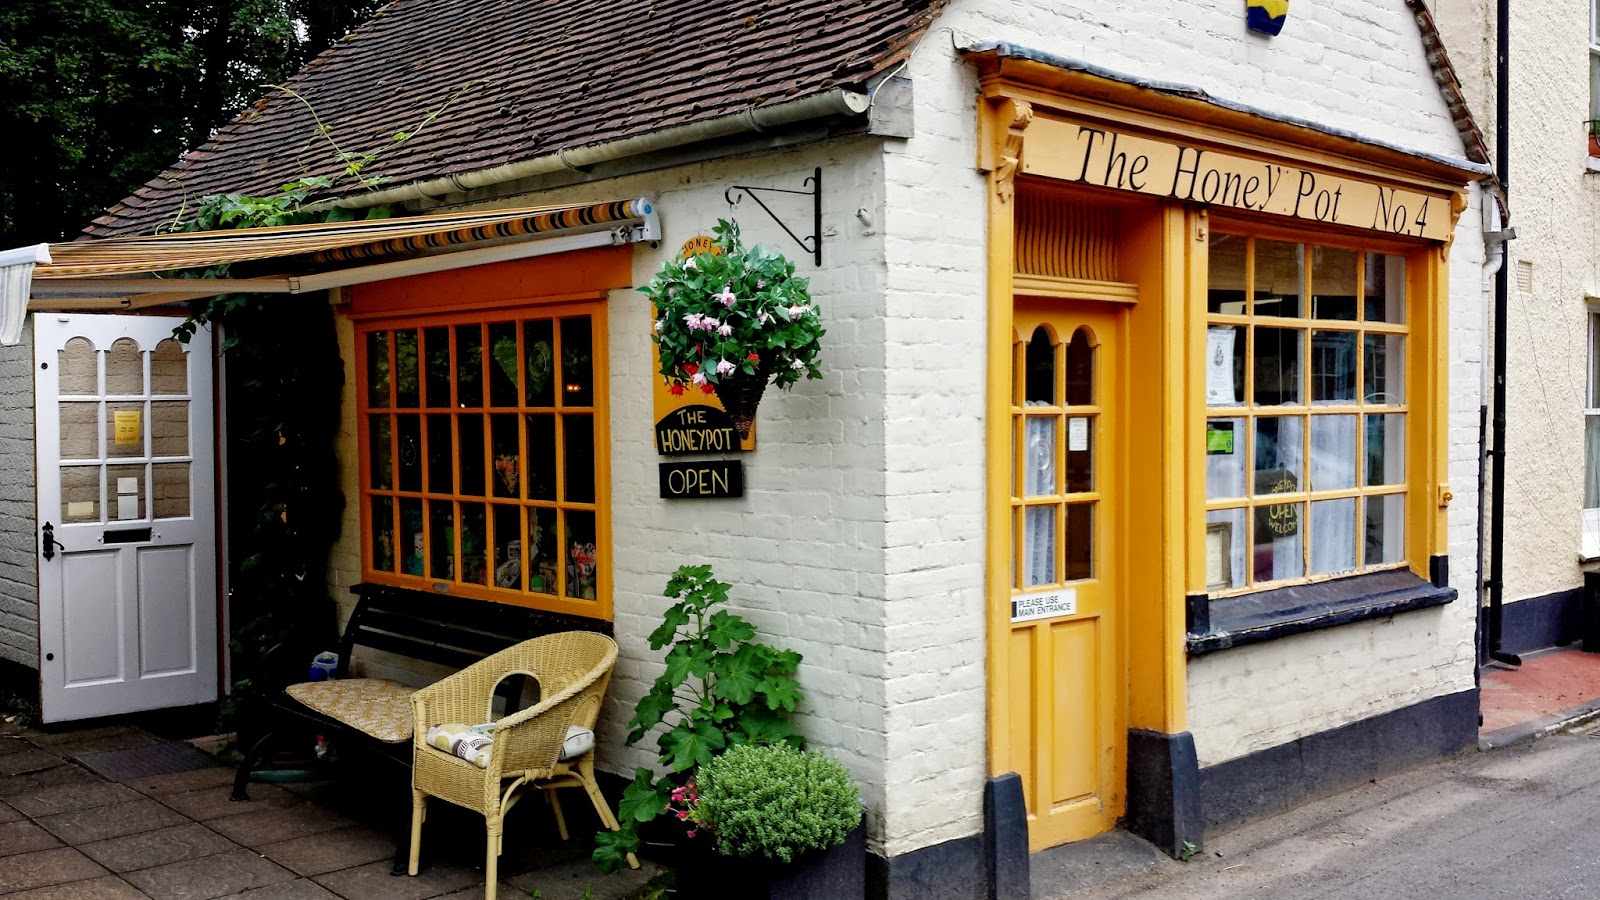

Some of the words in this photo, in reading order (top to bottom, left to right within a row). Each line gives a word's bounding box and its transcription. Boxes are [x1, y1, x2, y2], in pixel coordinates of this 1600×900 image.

[1076, 126, 1149, 191] The
[1291, 170, 1343, 223] Pot
[1370, 186, 1430, 238] No.4
[677, 409, 707, 425] THE
[660, 427, 733, 453] HONEYPOT
[668, 468, 729, 495] OPEN
[1018, 598, 1043, 609] PLEASE
[1045, 595, 1059, 605] USE
[1018, 607, 1035, 617] MAIN
[1037, 602, 1071, 615] ENTRANCE
